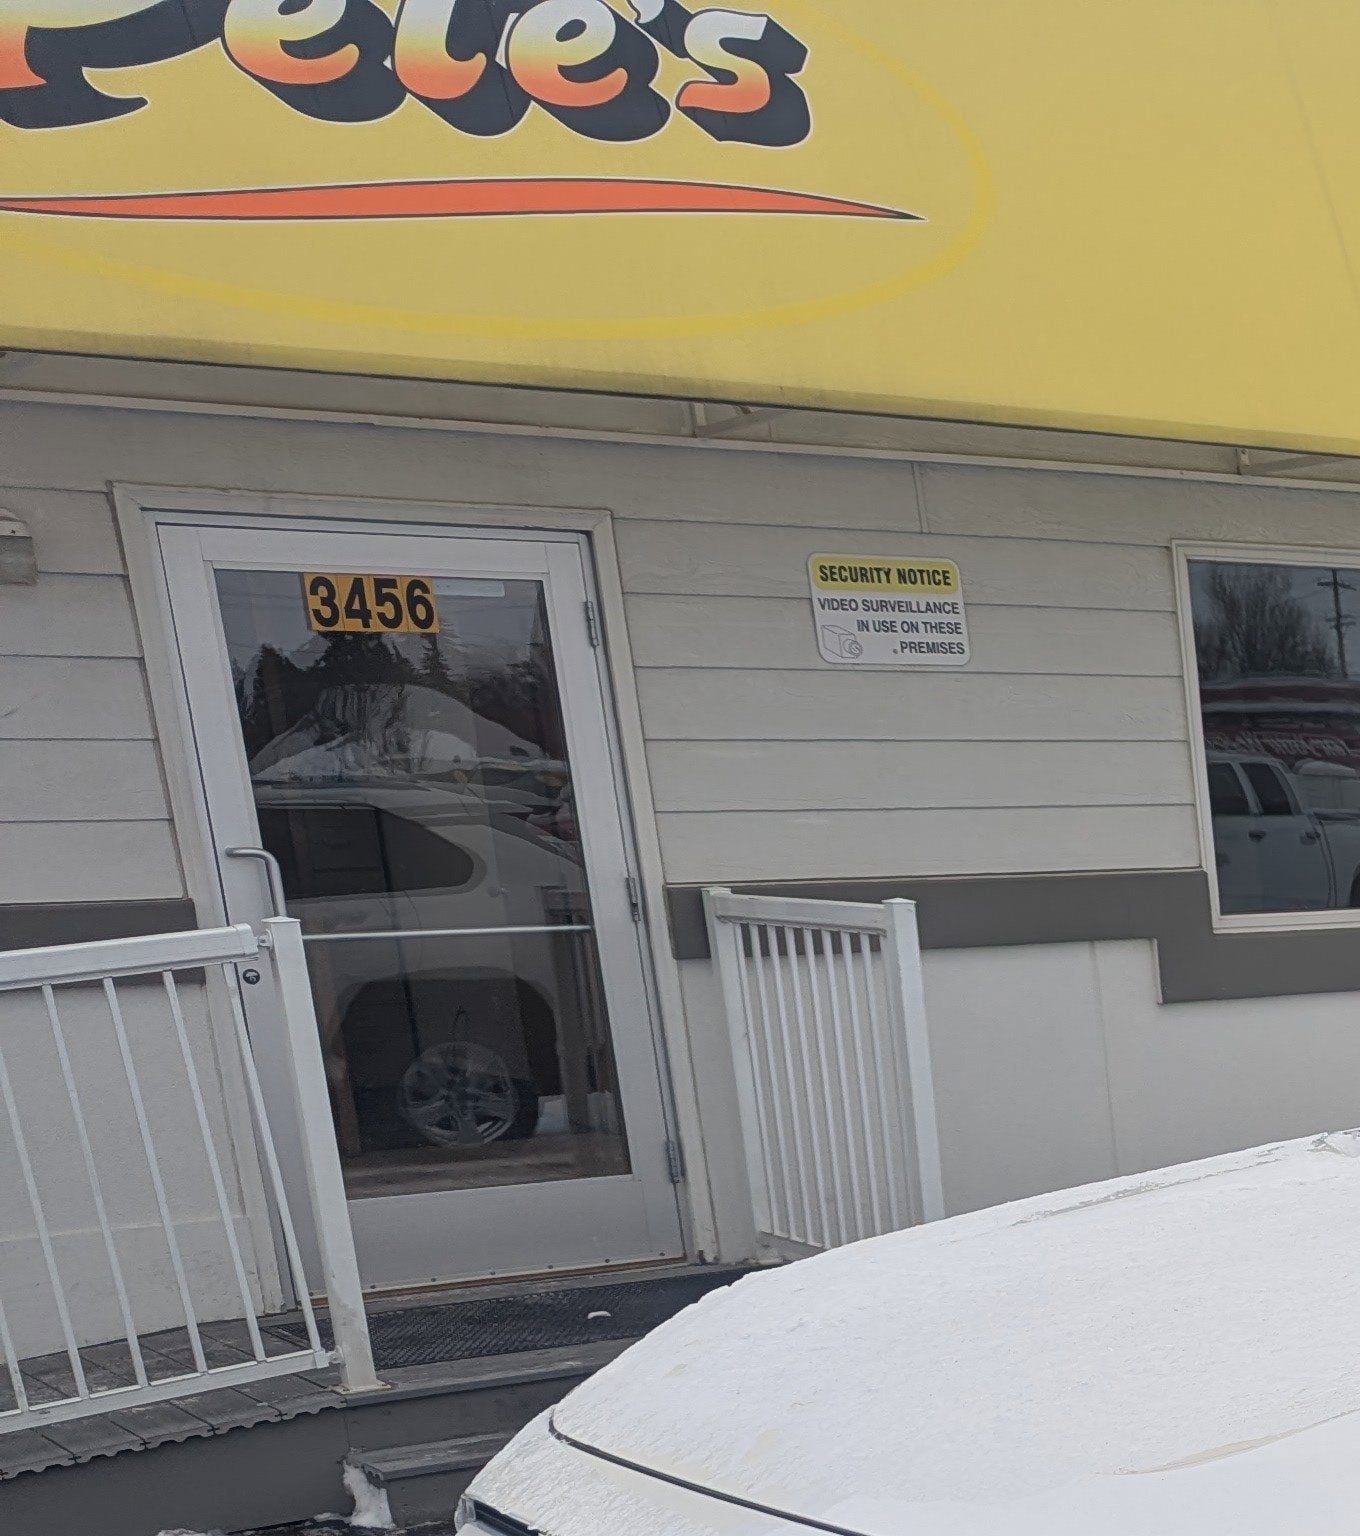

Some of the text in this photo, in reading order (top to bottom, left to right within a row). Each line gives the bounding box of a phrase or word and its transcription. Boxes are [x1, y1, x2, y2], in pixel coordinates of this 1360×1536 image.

[818, 564, 952, 586] SECURITY NOTICE
[310, 576, 434, 629] 3456
[817, 597, 960, 614] VIDEO SURVEILLANCE
[856, 619, 963, 634] IN USE ON THESE
[900, 641, 965, 655] PREMISES
